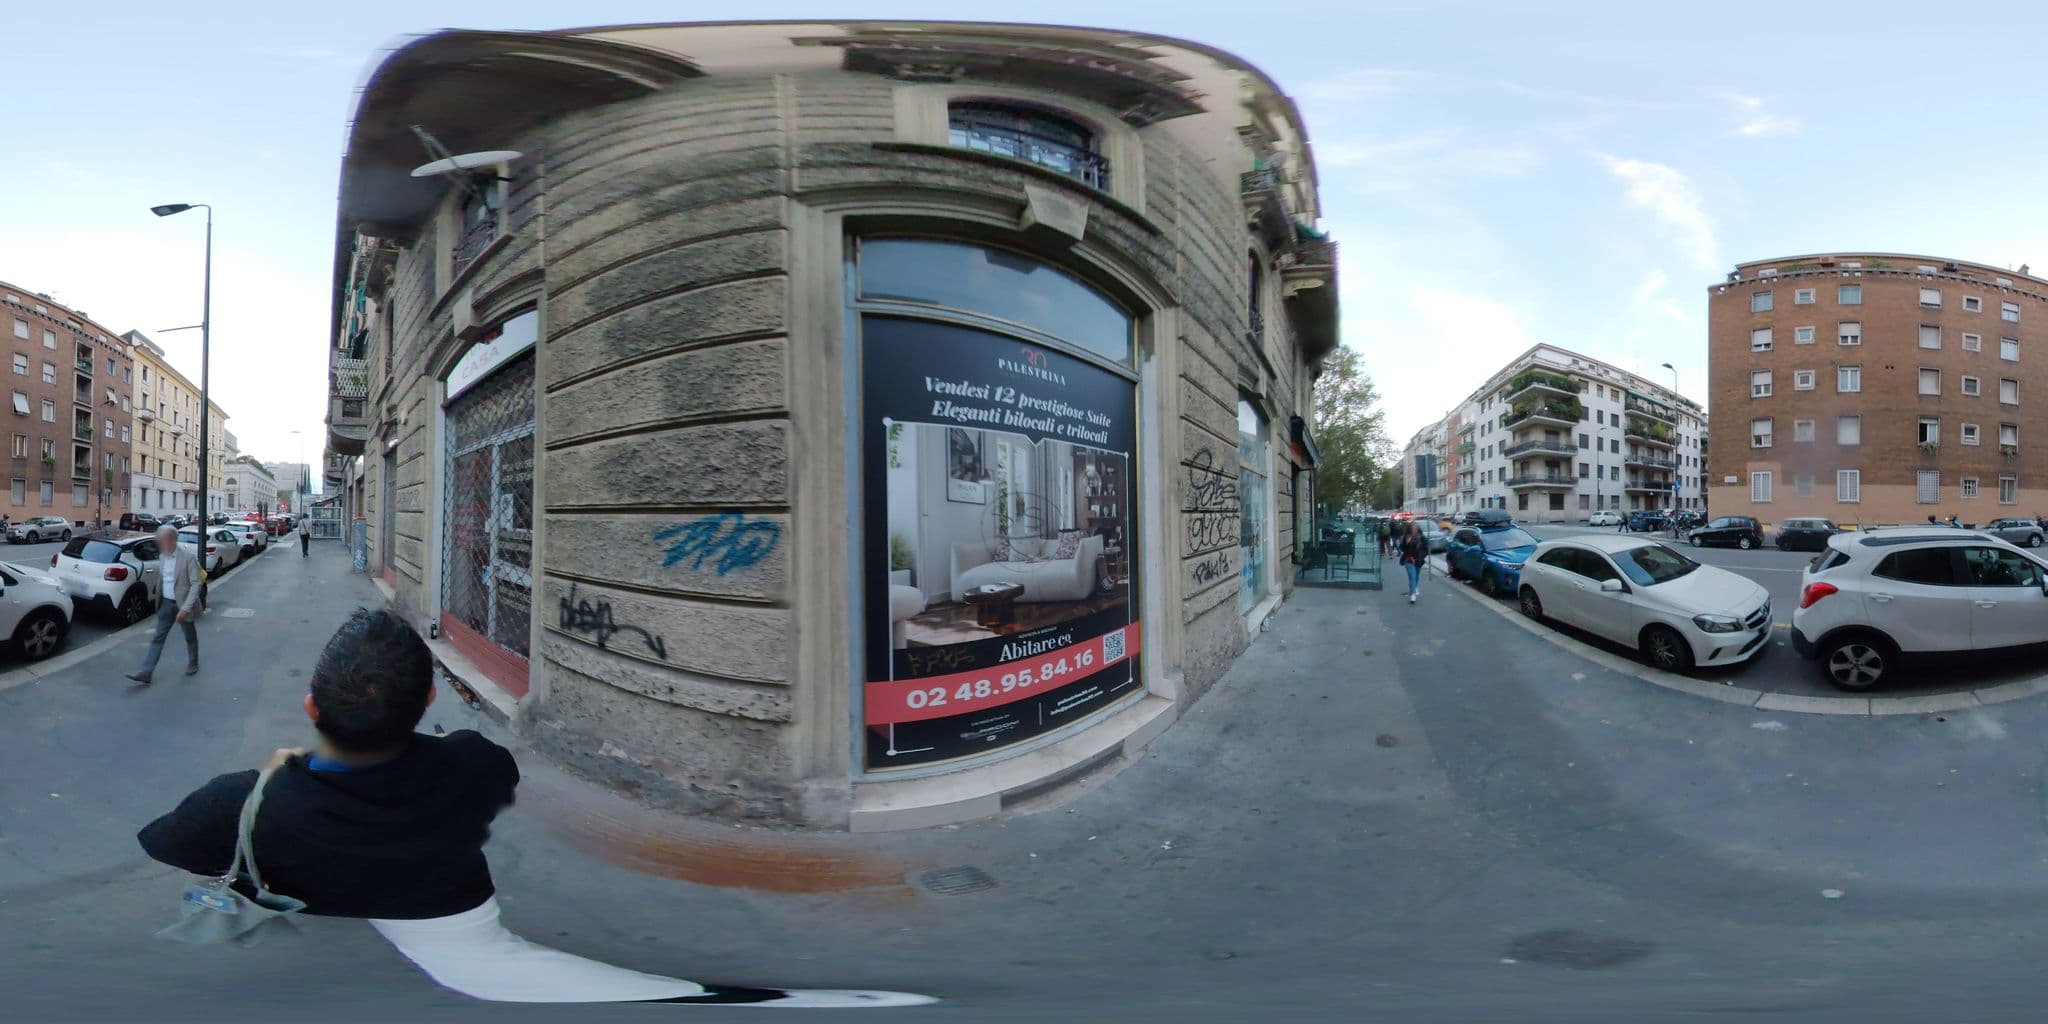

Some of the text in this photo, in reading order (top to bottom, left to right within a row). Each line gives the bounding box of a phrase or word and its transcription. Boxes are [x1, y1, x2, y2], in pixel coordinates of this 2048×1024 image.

[998, 357, 1066, 386] PALESTRINA
[925, 375, 1112, 428] Vendesi 12 prestigiose Suite
[931, 399, 1108, 444] Eleganti bilocali e trilocali
[999, 638, 1057, 662] Abitare
[906, 687, 948, 709] 02
[954, 649, 1094, 700] 48.95.84.16
